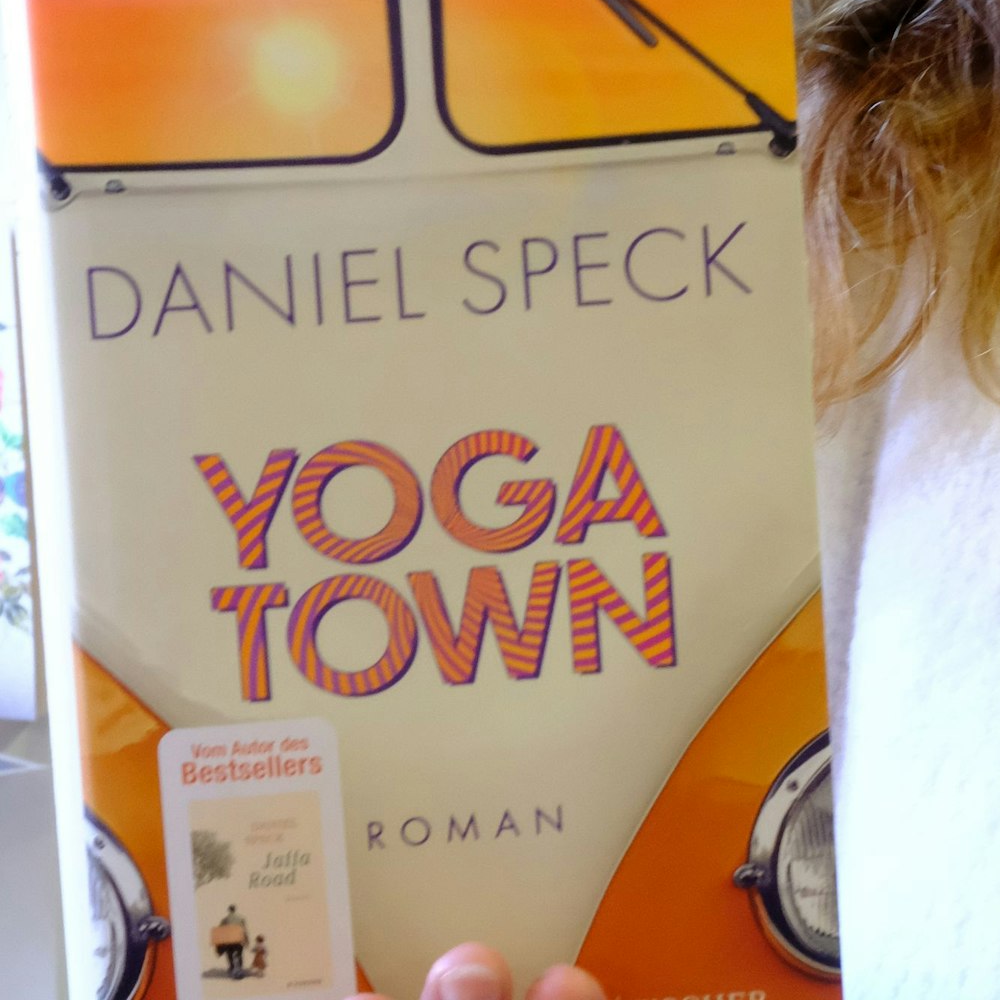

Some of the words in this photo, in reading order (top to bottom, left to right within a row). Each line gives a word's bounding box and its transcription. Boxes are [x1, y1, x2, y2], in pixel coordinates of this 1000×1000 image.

[87, 246, 426, 341] DANIEL
[463, 221, 752, 316] SPECK
[192, 424, 668, 570] YOGA
[210, 552, 677, 702] TOWN
[191, 744, 227, 758] Vom
[232, 740, 275, 755] Autor
[280, 736, 309, 751] des
[181, 755, 323, 785] Bestsellers
[366, 804, 565, 851] ROMAN
[263, 848, 312, 869] Jaffa
[248, 868, 297, 889] Road
